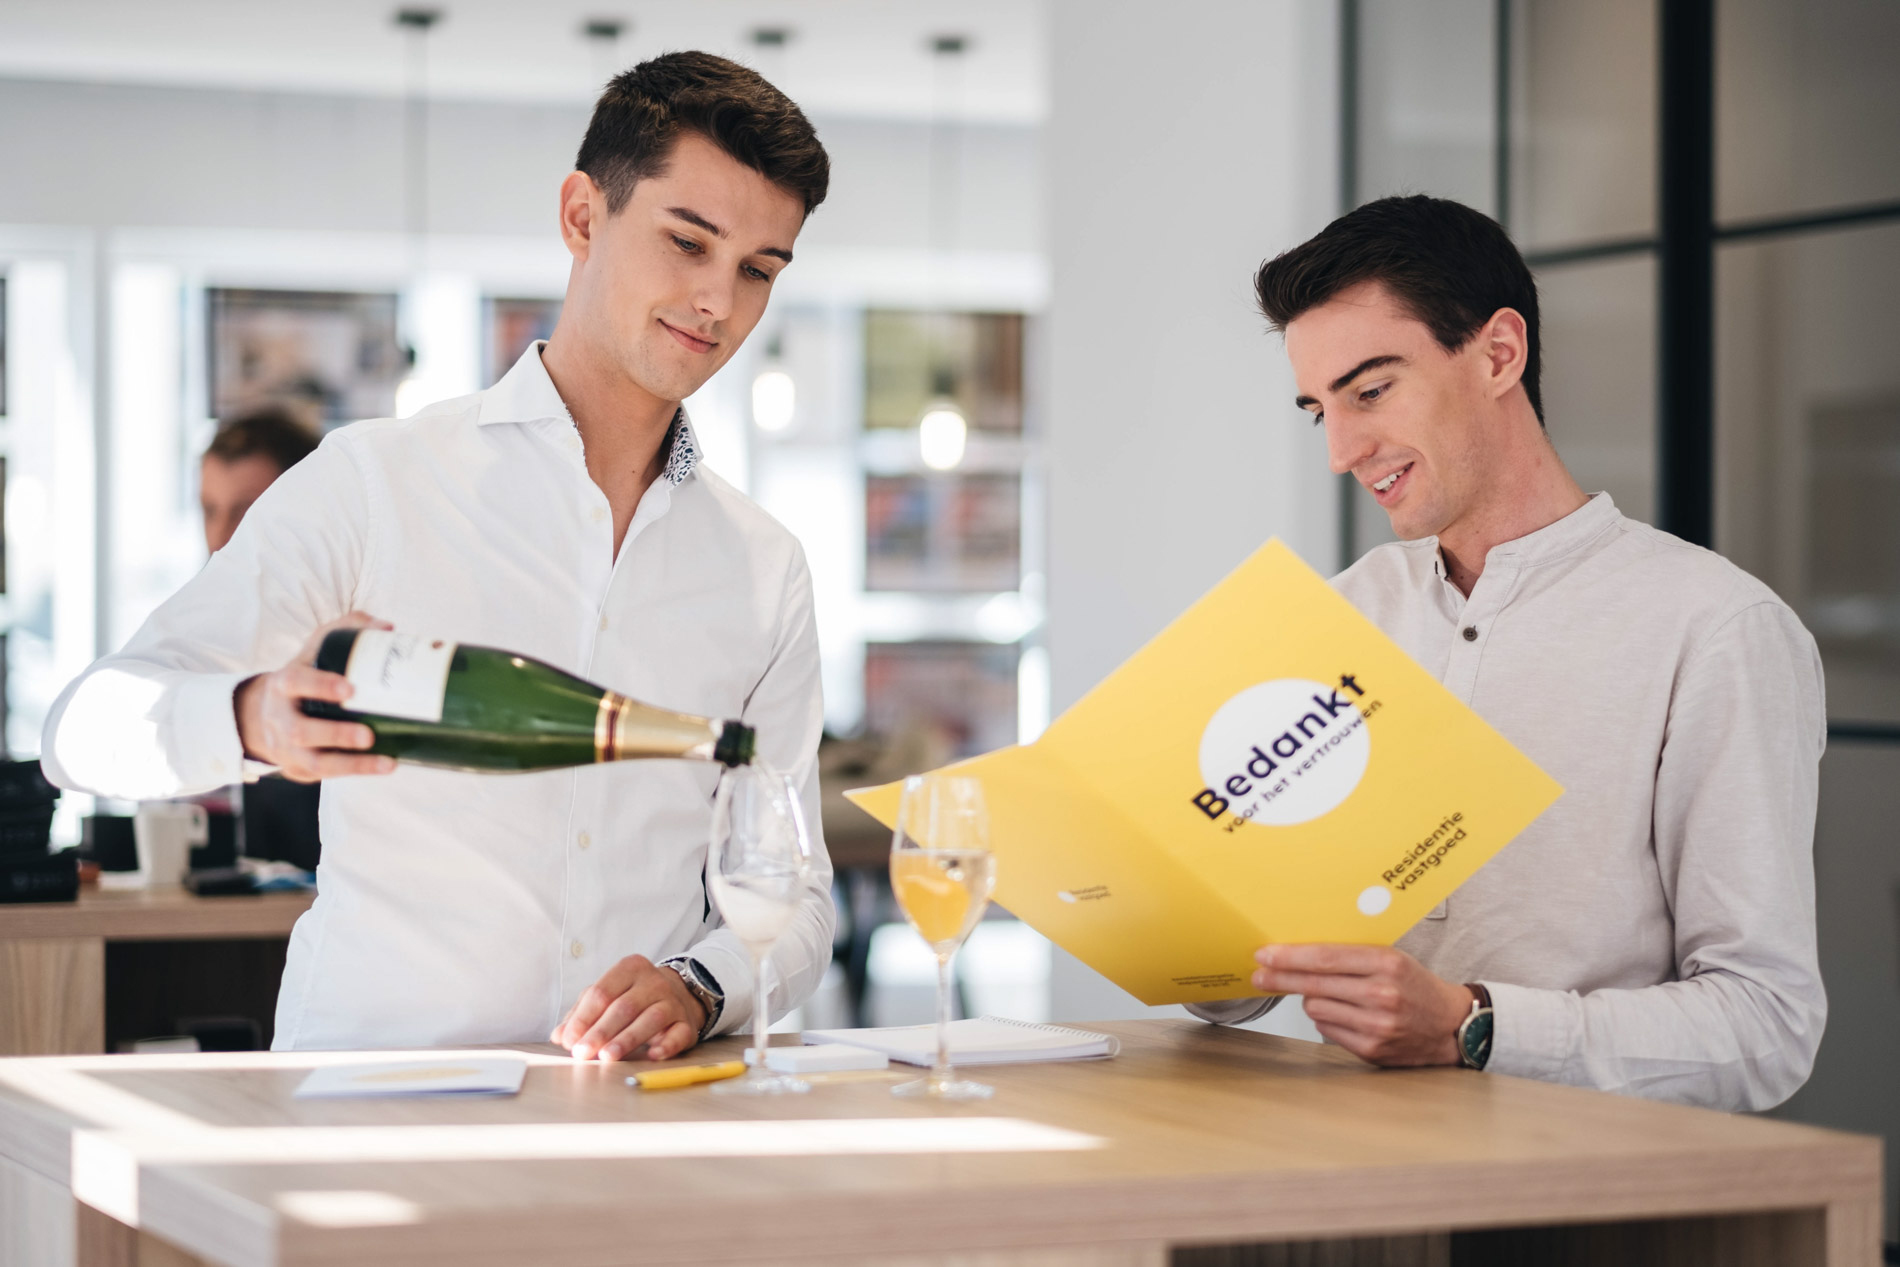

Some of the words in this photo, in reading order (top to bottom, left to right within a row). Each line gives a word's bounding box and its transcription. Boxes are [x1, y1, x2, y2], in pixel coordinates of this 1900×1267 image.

[1191, 673, 1366, 820] Bedankt
[1223, 802, 1260, 834] voor
[1260, 777, 1290, 802] het
[1292, 699, 1383, 777] vertrouwen
[1382, 811, 1464, 883] Residentie
[1395, 827, 1467, 891] vastgoed
